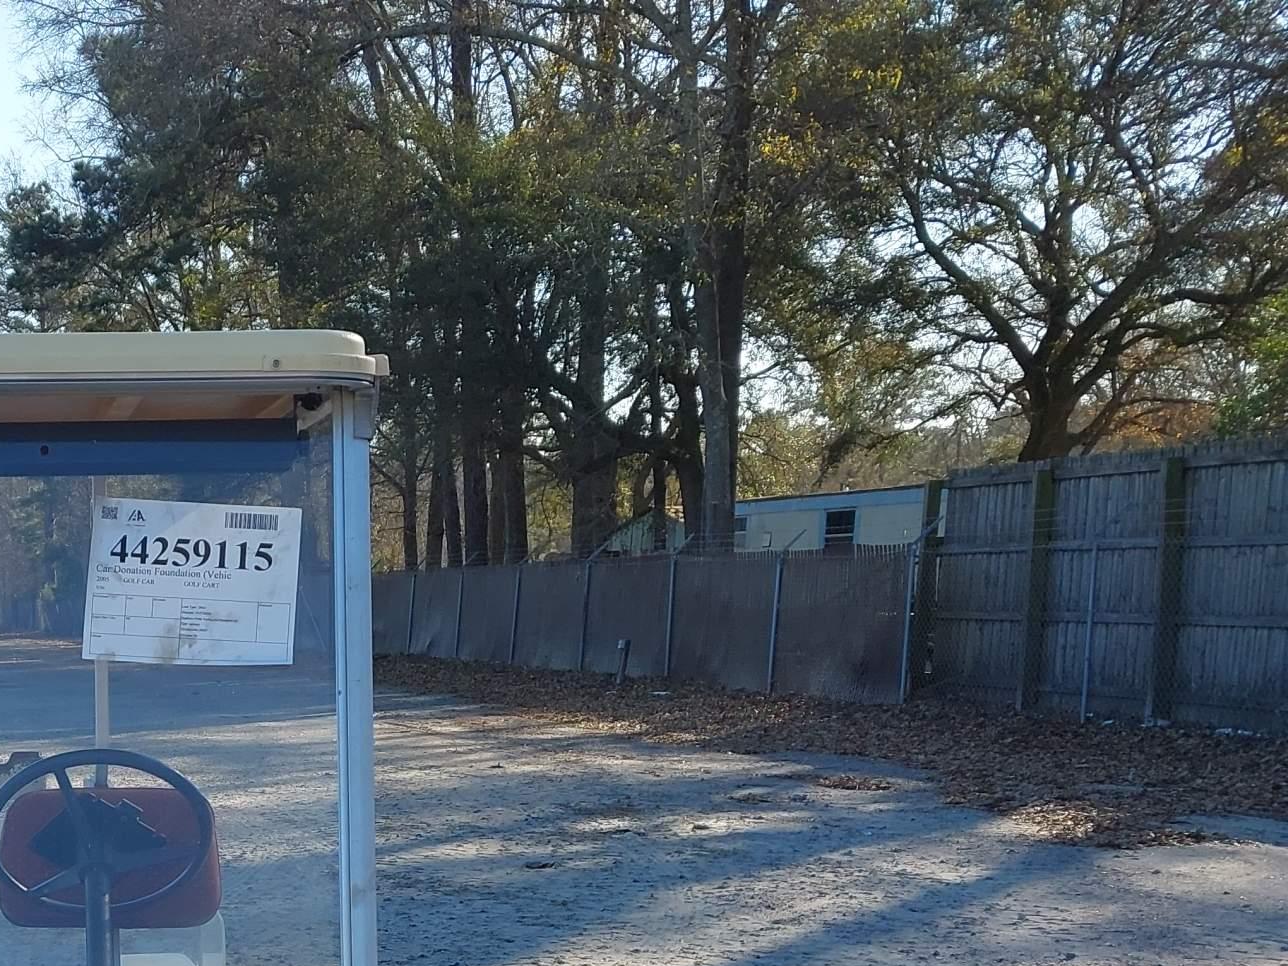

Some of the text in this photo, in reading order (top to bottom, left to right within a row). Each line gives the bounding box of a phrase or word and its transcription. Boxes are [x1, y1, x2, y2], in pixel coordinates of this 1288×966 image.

[110, 534, 274, 572] 44259115
[113, 565, 152, 576] Donation
[154, 567, 201, 578] Foundation
[203, 569, 232, 581] (Vehic
